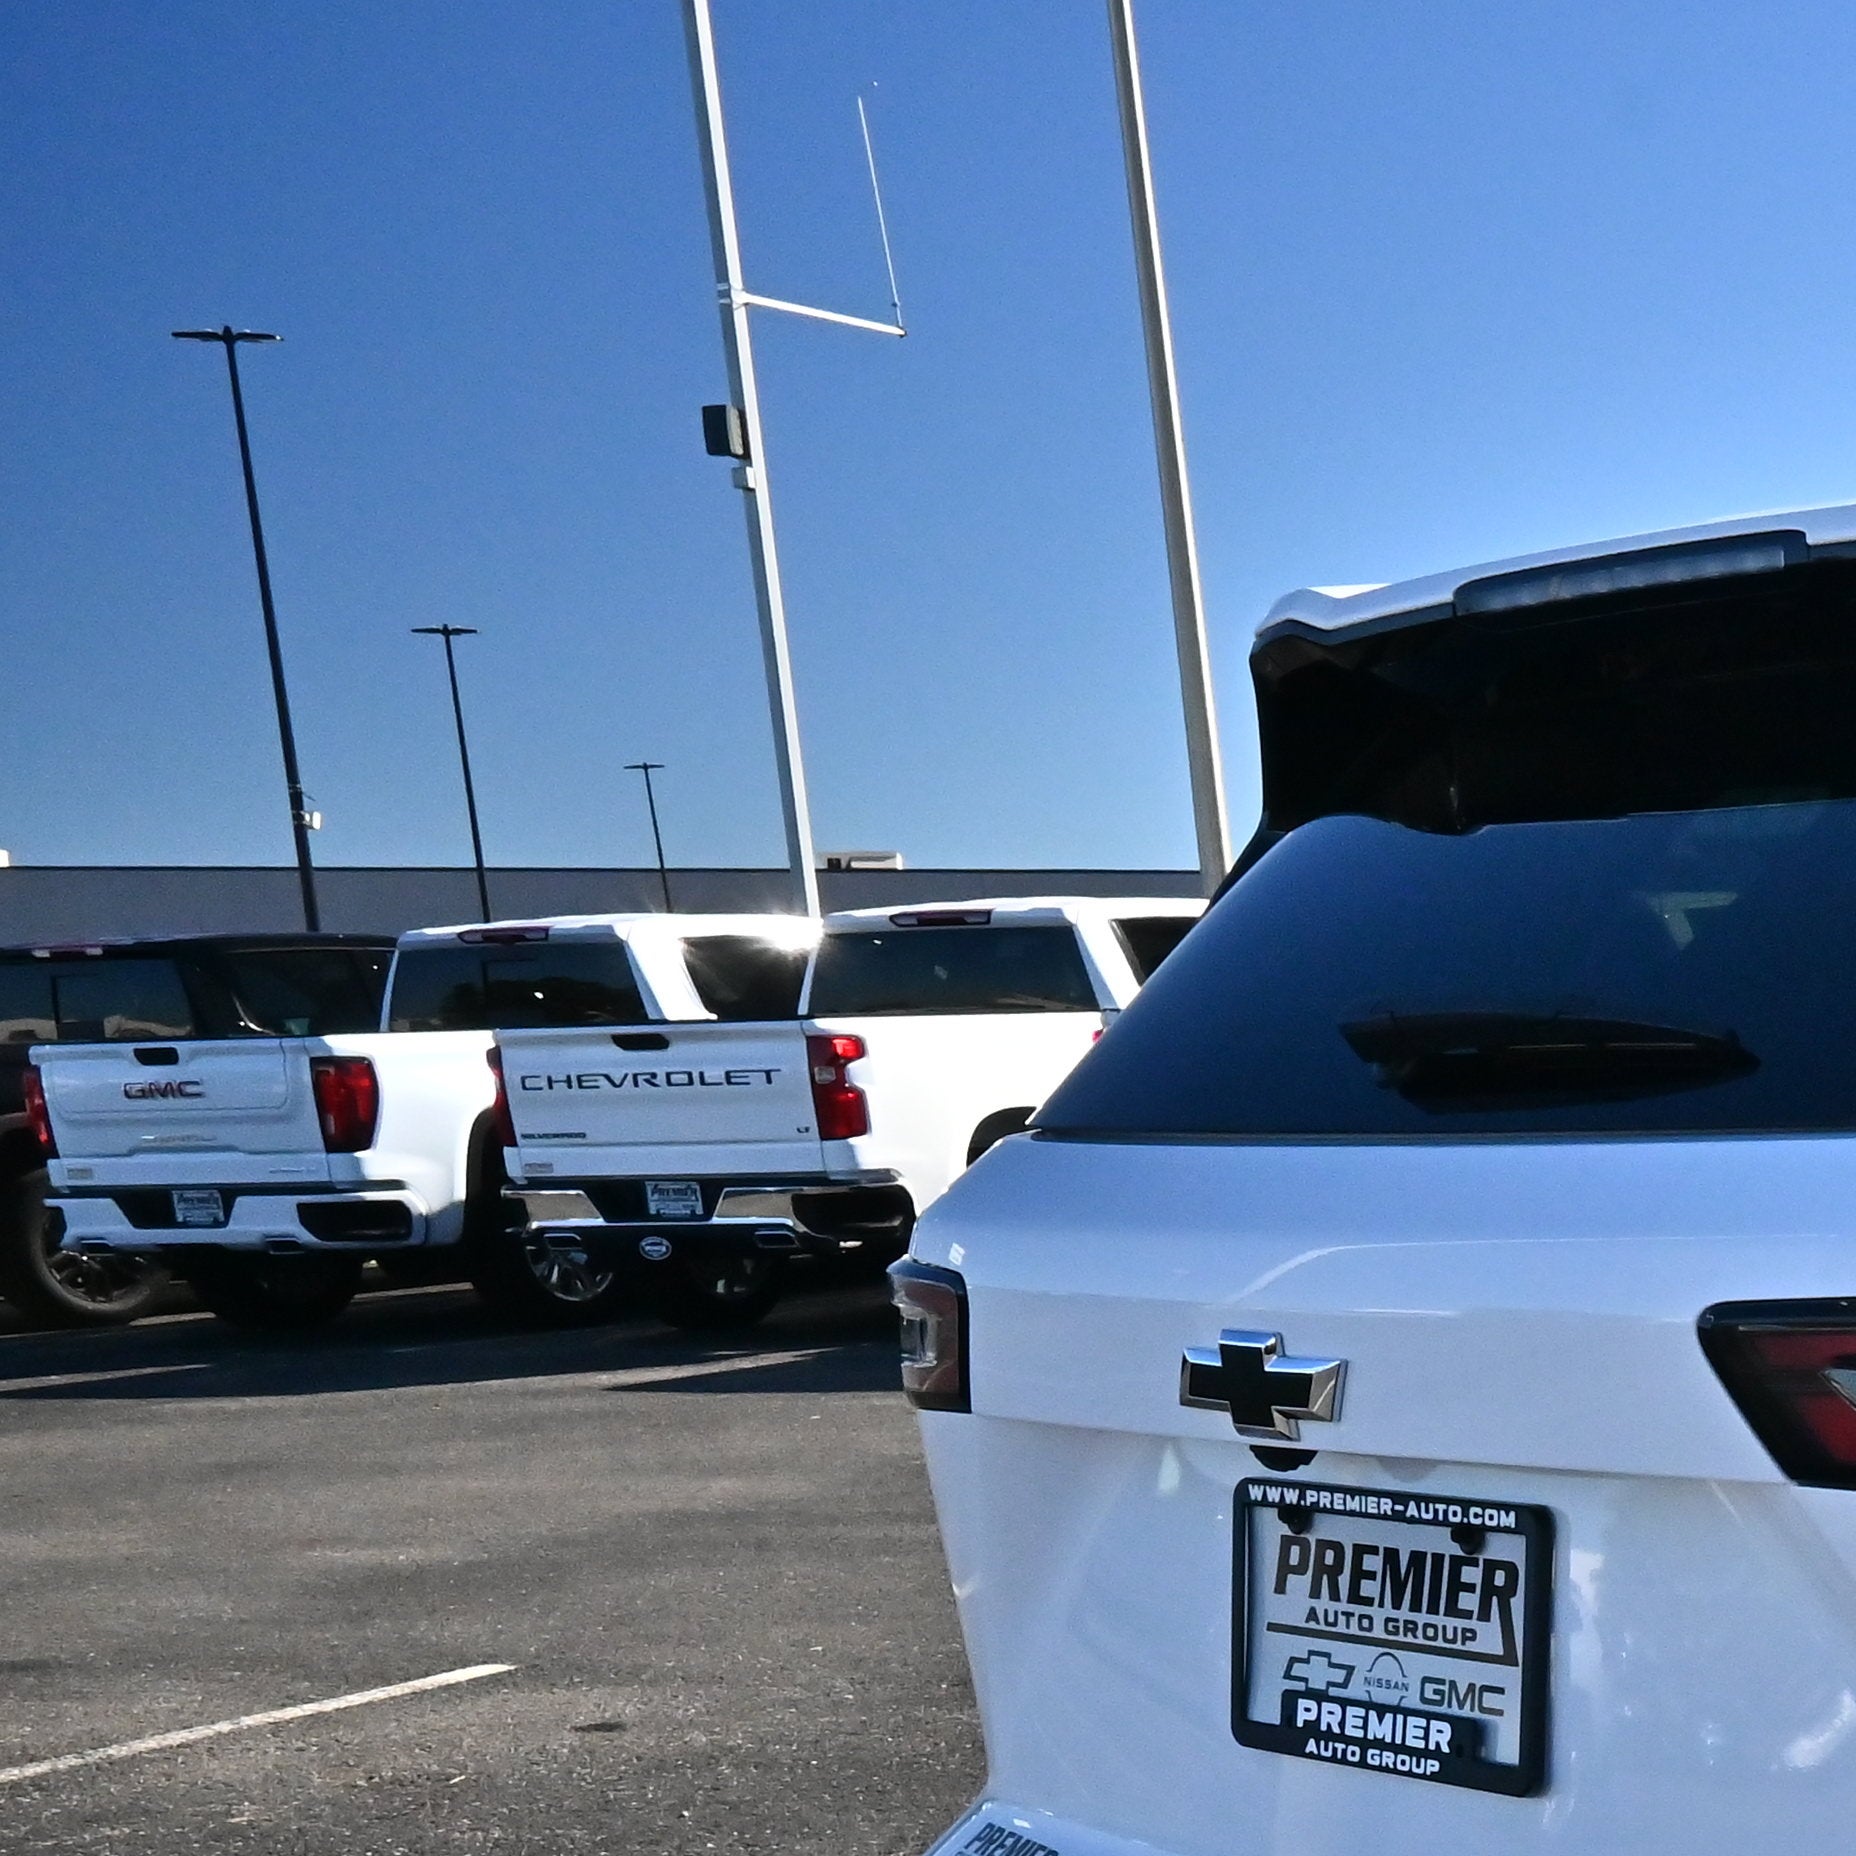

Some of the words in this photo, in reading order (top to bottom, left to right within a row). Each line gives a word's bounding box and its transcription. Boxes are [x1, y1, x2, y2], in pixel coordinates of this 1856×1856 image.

[123, 1081, 204, 1099] GMC
[520, 1069, 782, 1091] CHEVROLET
[1248, 1483, 1517, 1530] WWW.PREMIER-AUTO.COM
[1273, 1534, 1520, 1623] PREMIER
[1304, 1606, 1374, 1633] AUTO
[1383, 1616, 1478, 1646] GROUP
[1363, 1676, 1409, 1692] NISSAN
[1419, 1675, 1505, 1717] GMC
[1296, 1698, 1452, 1753] PREMIER
[1304, 1738, 1360, 1763] AUTO
[1366, 1749, 1441, 1775] GROUP
